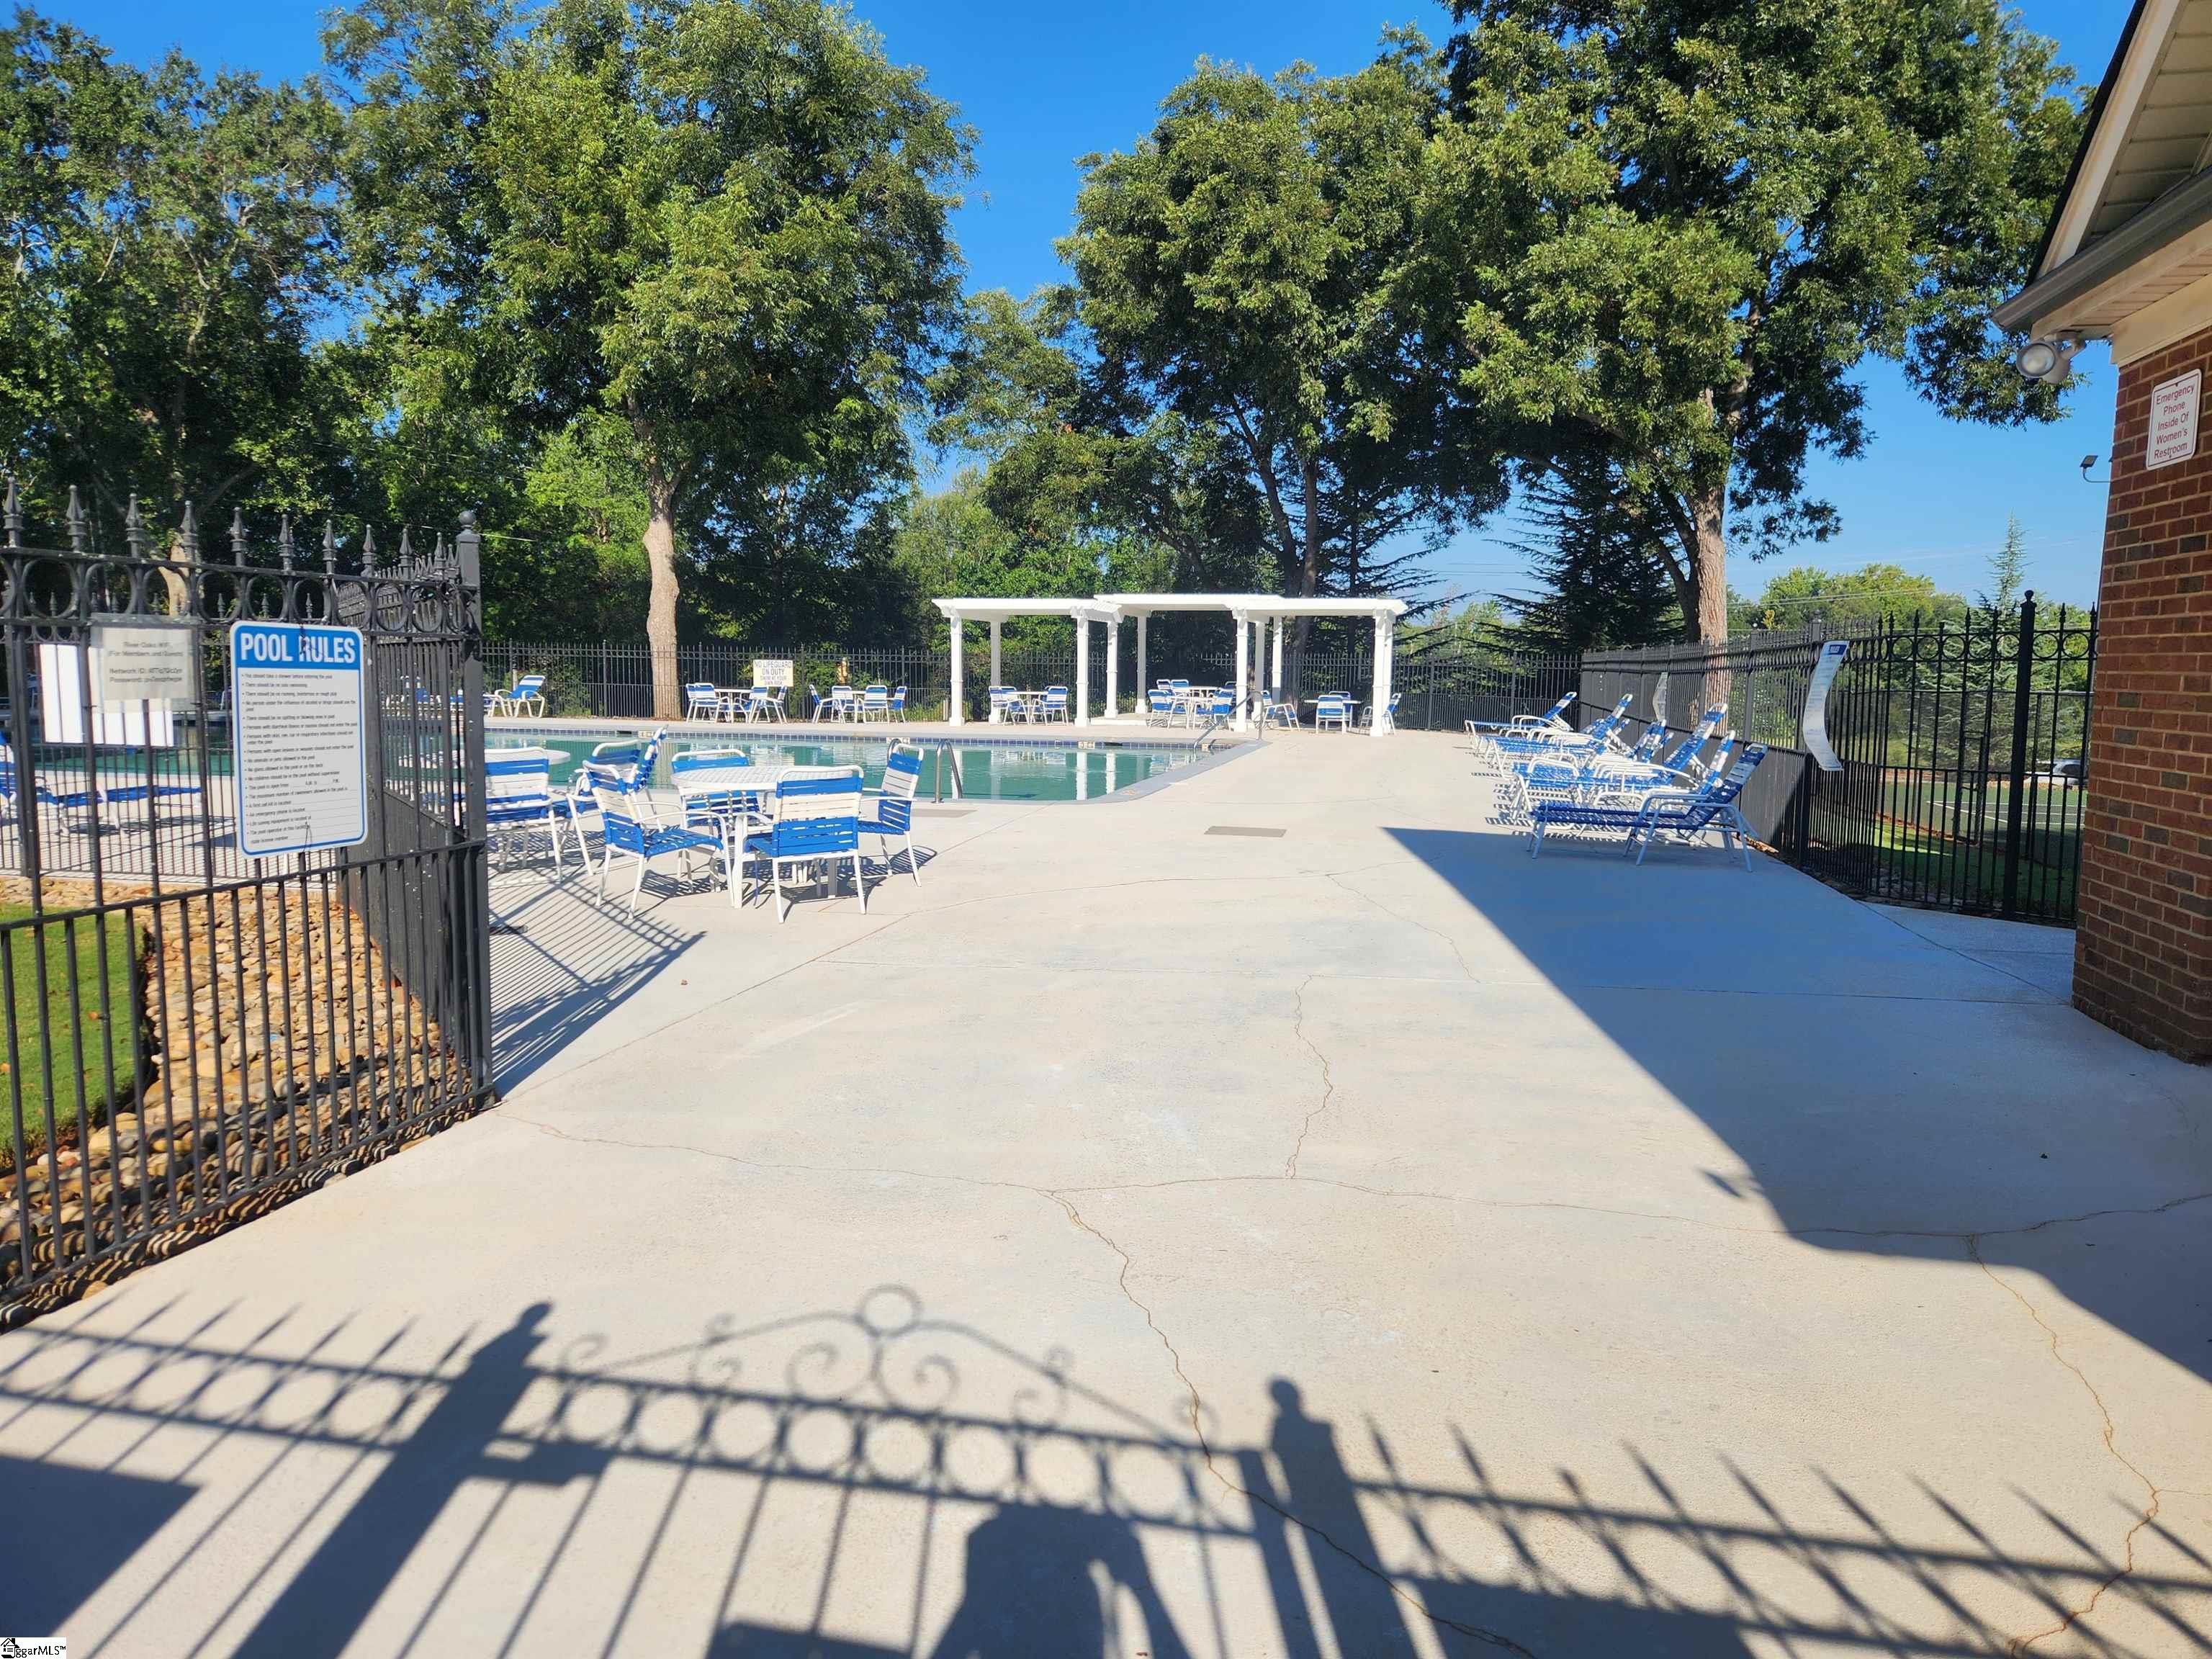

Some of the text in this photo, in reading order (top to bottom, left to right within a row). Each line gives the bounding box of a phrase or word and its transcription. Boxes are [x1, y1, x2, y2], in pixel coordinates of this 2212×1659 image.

[2156, 385, 2195, 405] Emergency
[2163, 401, 2185, 415] Phone
[2157, 411, 2190, 431] Inside Of
[2156, 428, 2188, 445] Women's
[2154, 442, 2188, 459] Restroom
[240, 633, 356, 663] POOL RULES
